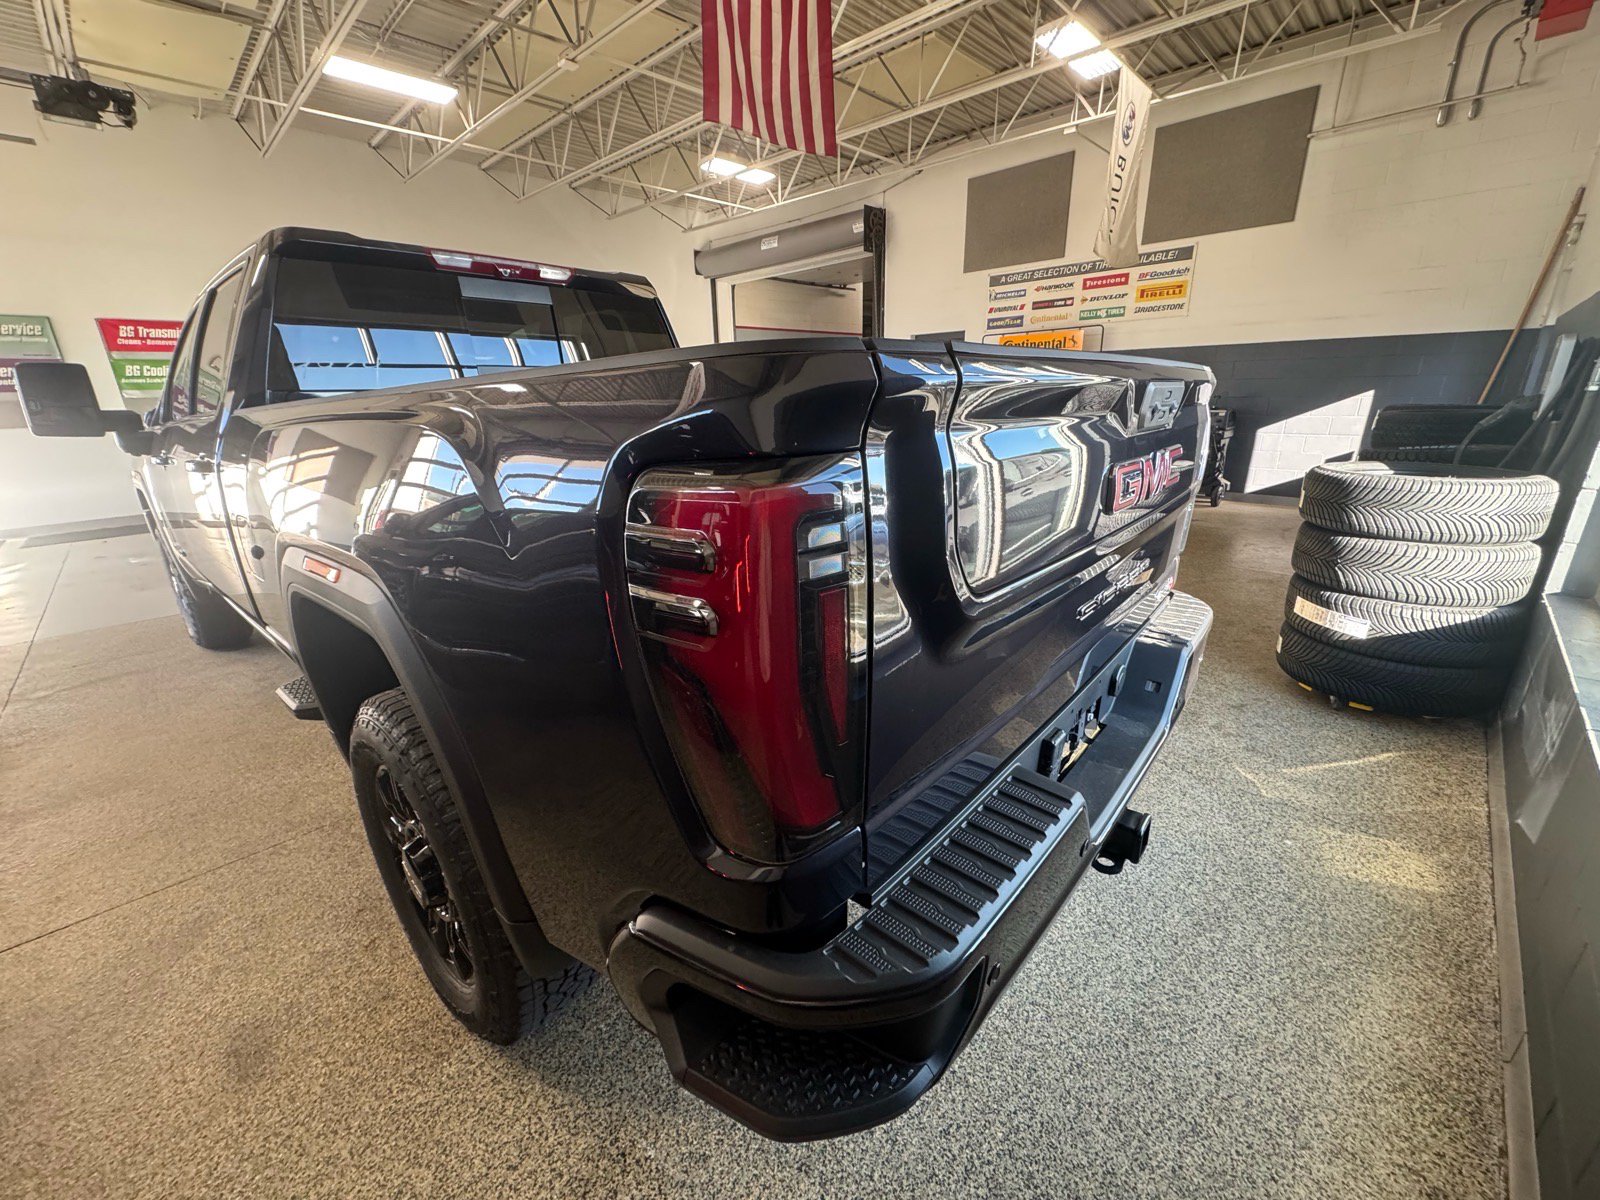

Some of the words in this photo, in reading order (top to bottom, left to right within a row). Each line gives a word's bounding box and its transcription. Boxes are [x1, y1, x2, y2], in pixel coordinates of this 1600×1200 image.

[1000, 275, 1006, 284] A
[1007, 272, 1032, 283] GREAT
[1033, 264, 1080, 279] SELECTION
[1080, 262, 1094, 273] OF
[1140, 250, 1178, 263] ILABLE!
[1138, 267, 1190, 280] BFGoodrich
[1086, 276, 1126, 288] Firestone
[996, 290, 1025, 298] MICHELIN
[1089, 293, 1128, 302] DUNLOP
[1140, 284, 1184, 299] PIRELLI
[1107, 308, 1124, 316] TIRES
[1134, 303, 1185, 314] BRIDGESTONE
[1, 323, 42, 335] ervice
[119, 325, 134, 338] BG
[137, 326, 182, 338] Transmi
[125, 364, 141, 377] BG
[143, 364, 169, 377] Cooli
[1112, 443, 1184, 513] GMC
